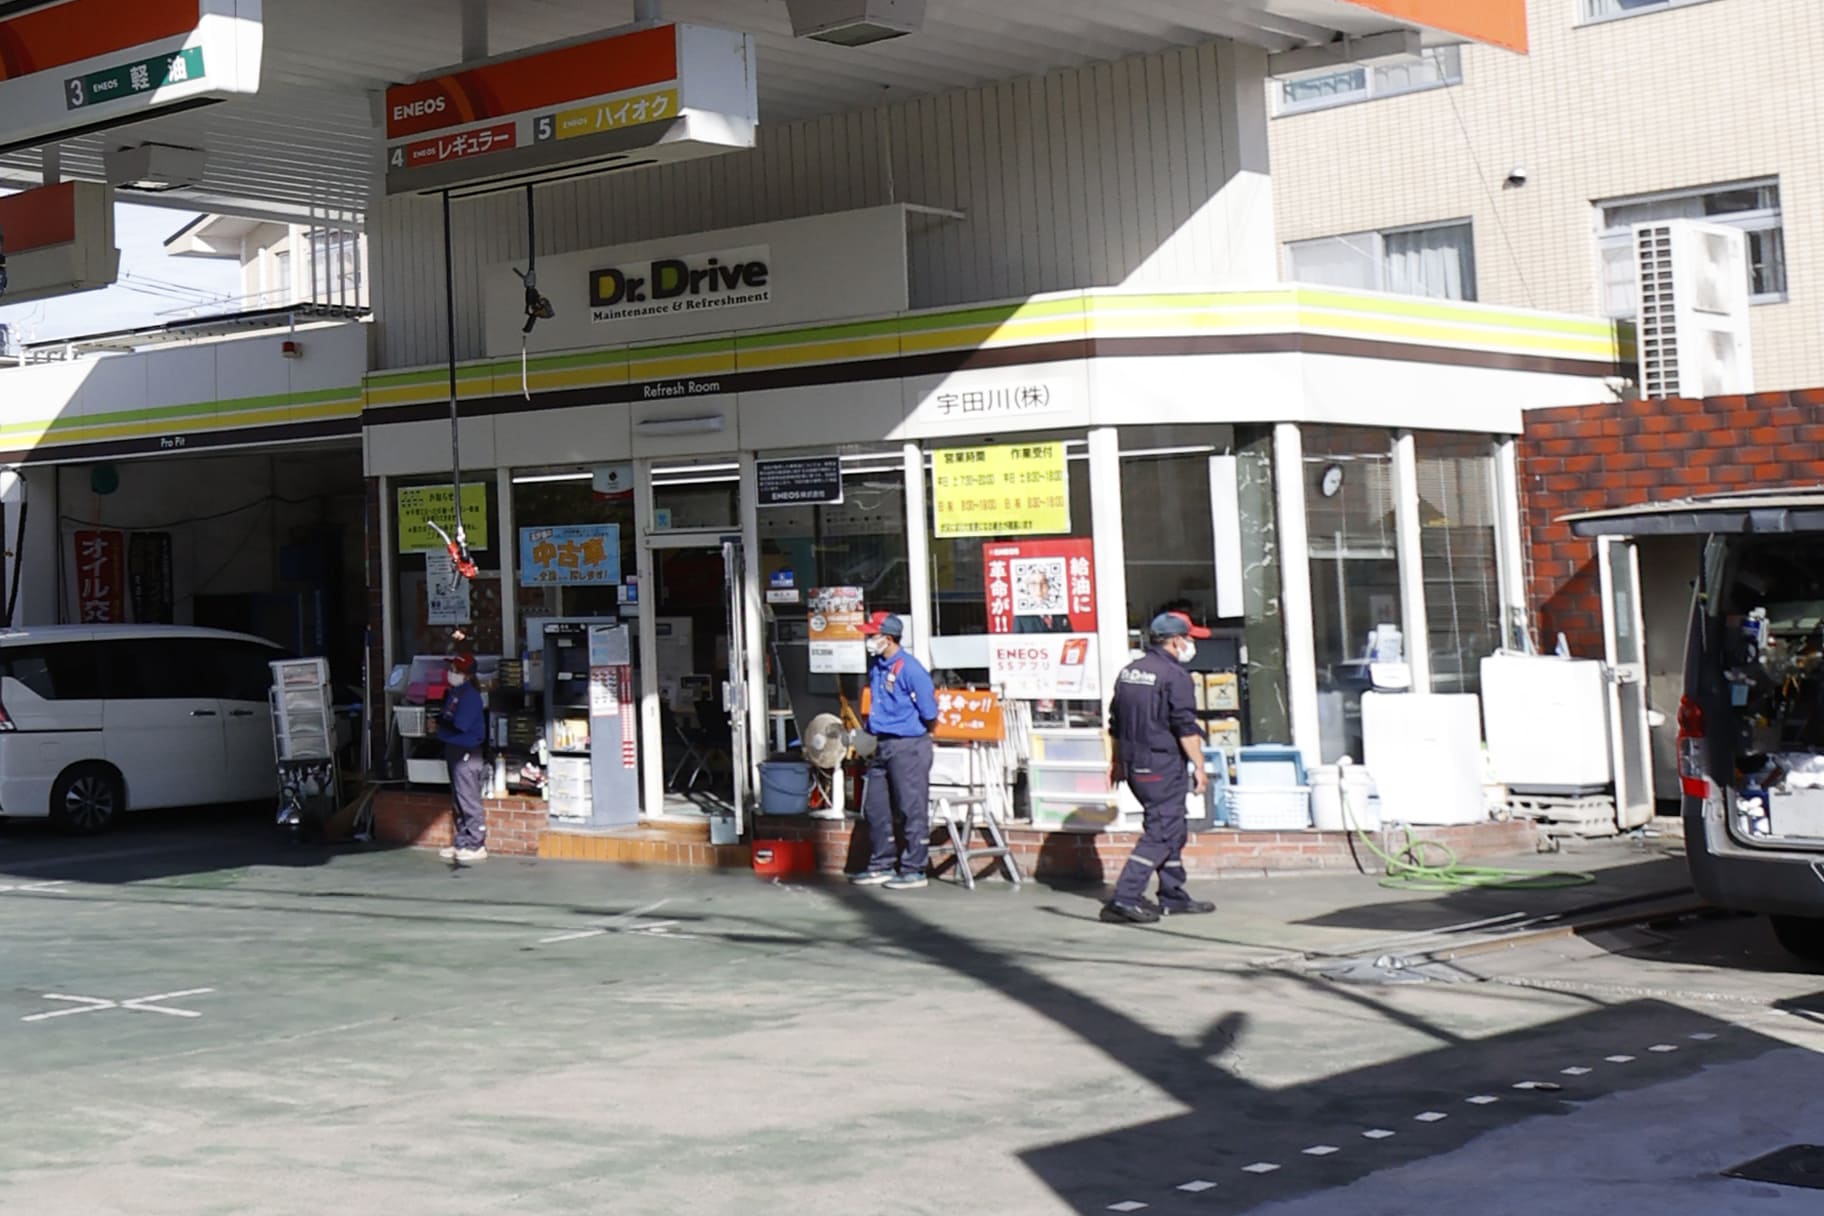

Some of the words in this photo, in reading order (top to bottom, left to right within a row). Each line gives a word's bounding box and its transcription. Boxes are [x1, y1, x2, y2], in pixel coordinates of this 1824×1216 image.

[70, 79, 84, 107] 3
[92, 79, 119, 93] ENEOS
[129, 55, 189, 92] 軽油
[393, 95, 446, 121] ENEOS
[537, 117, 553, 141] 5
[595, 95, 670, 129] ハイオク
[390, 147, 405, 168] 4
[438, 130, 510, 161] レギュラー
[592, 303, 669, 322] Maintenance
[671, 300, 682, 312] &
[685, 291, 769, 311] Refreshment
[643, 383, 684, 398] Refresh
[688, 380, 720, 394] Room
[943, 450, 986, 464] 営業時間
[1010, 446, 1053, 461] 作業受付
[533, 536, 608, 569] 中古車
[81, 537, 111, 622] オイル交
[1069, 556, 1092, 614] 給油に
[996, 648, 1049, 660] ENEOS
[997, 661, 1051, 671] SSアプリ
